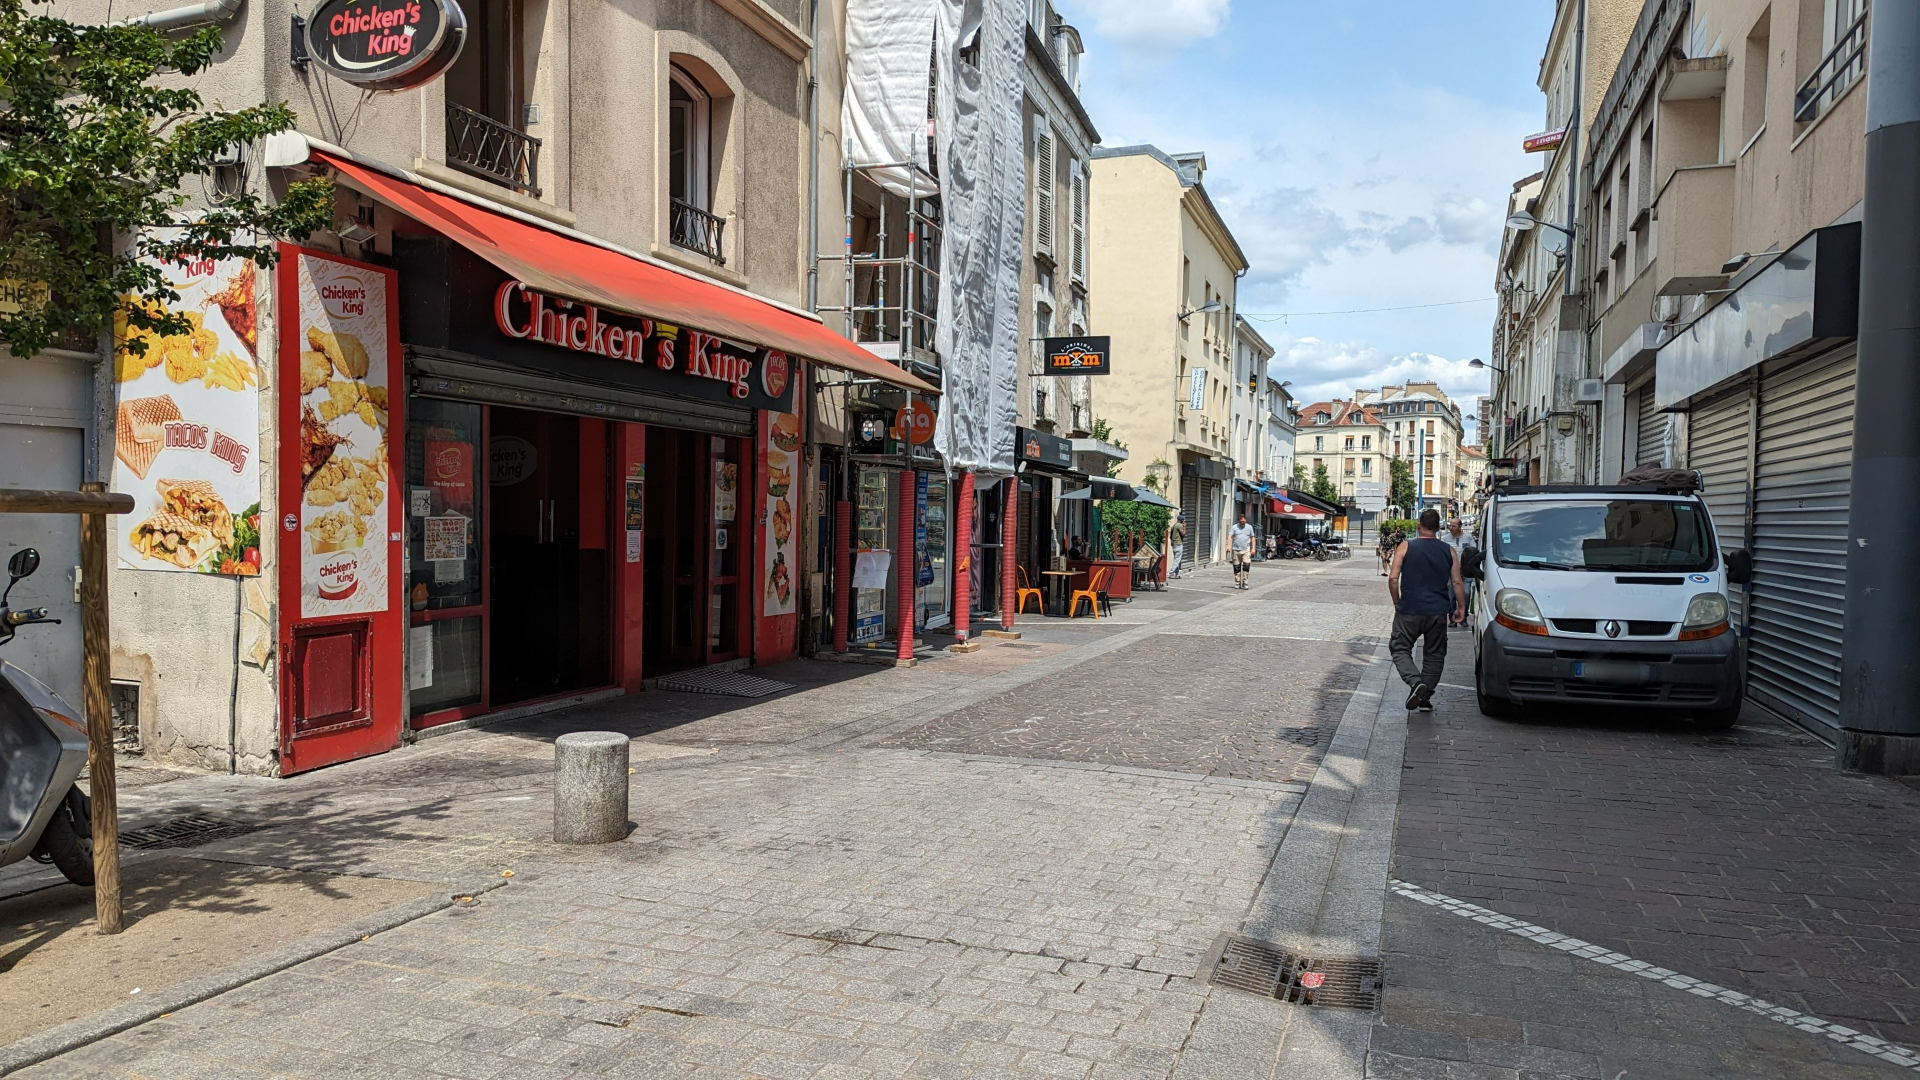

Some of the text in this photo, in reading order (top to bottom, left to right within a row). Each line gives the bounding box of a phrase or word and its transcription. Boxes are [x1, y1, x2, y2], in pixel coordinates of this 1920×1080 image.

[330, 2, 421, 37] Chicken's
[367, 28, 413, 56] King
[186, 256, 215, 279] King
[321, 284, 366, 300] Chicken's
[342, 299, 364, 316] King
[685, 329, 753, 400] King
[769, 355, 787, 371] TACOS
[165, 423, 208, 449] TACOS
[497, 462, 523, 478] King
[319, 559, 358, 577] Chicken's
[337, 571, 354, 584] King
